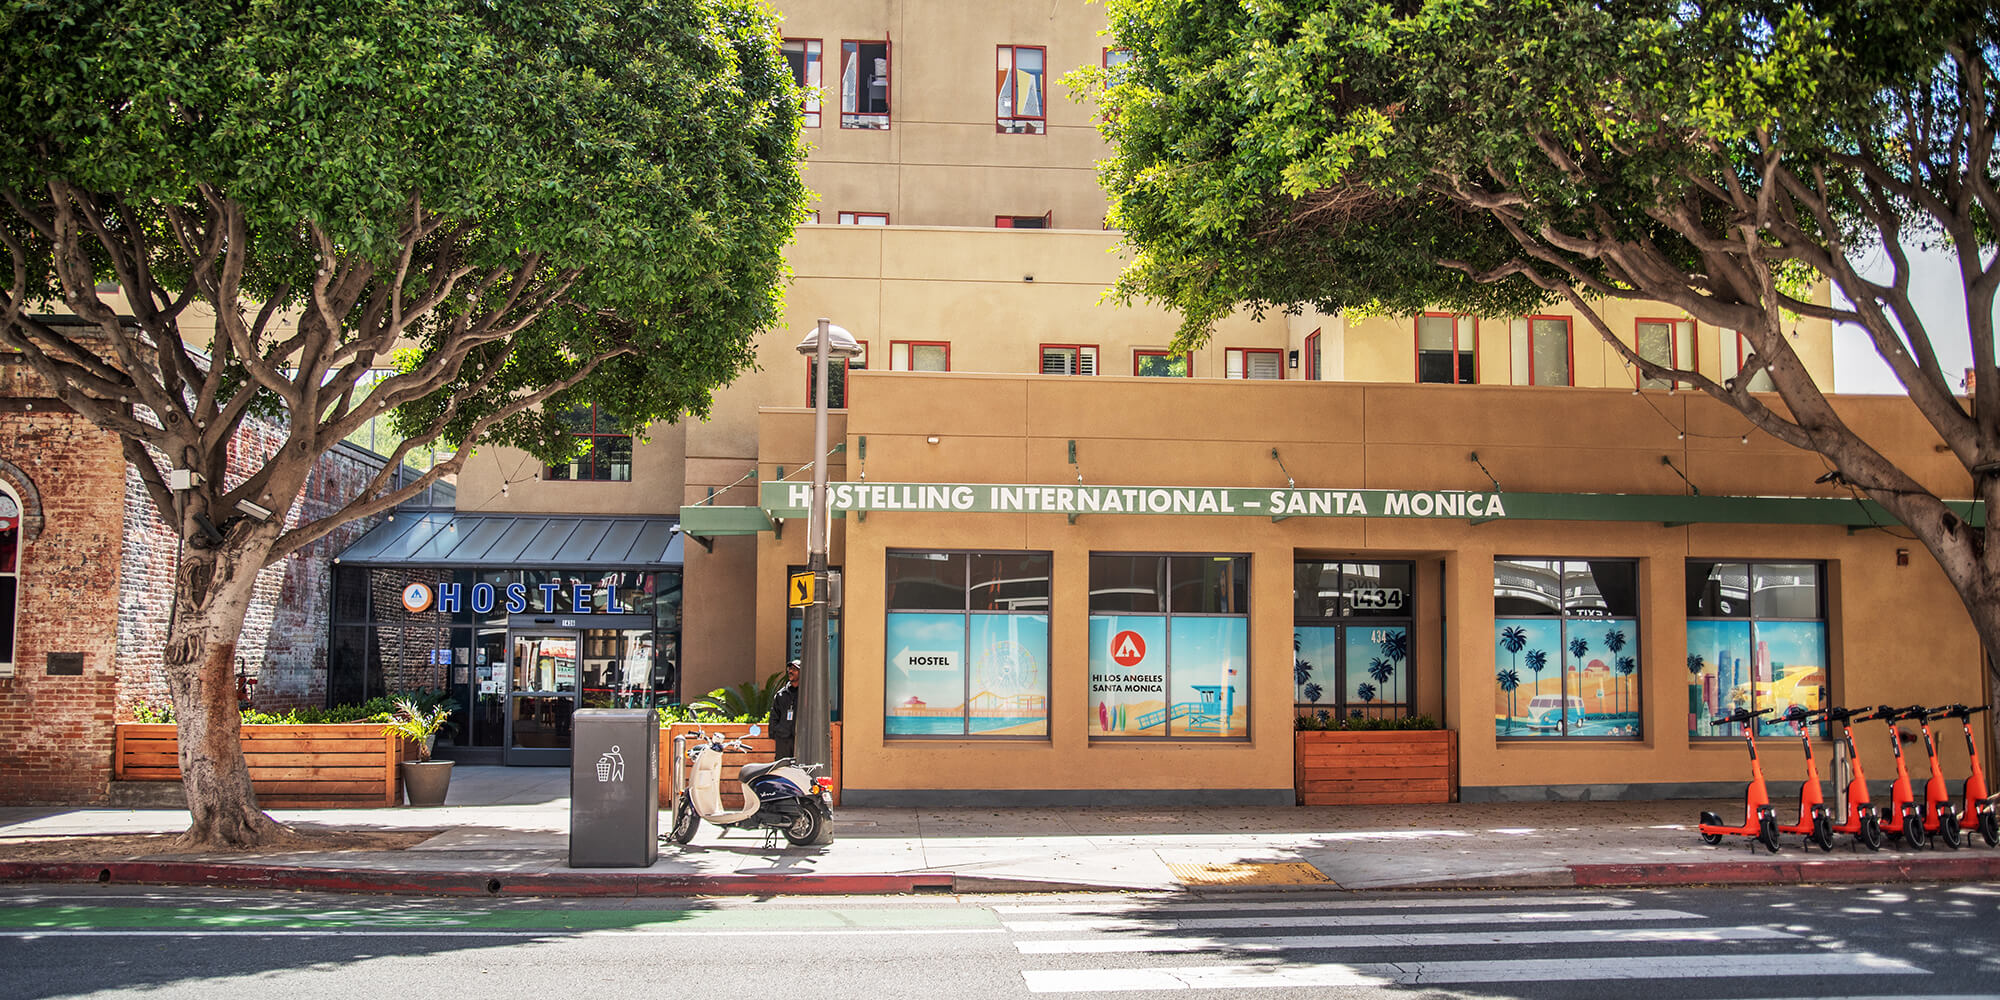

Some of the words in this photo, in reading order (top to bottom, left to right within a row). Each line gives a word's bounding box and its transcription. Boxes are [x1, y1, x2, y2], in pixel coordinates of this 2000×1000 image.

[990, 487, 1235, 513] INTERNATIONAL
[1269, 490, 1368, 515] SANTA
[1383, 493, 1506, 517] MONICA
[437, 582, 625, 615] HOSTEL
[1353, 590, 1401, 607] 1434
[909, 656, 950, 666] HOSTEL
[1092, 674, 1102, 682] HI
[1104, 674, 1121, 682] LOS
[1123, 675, 1163, 683] ANGELES
[1092, 684, 1122, 692] SANTA
